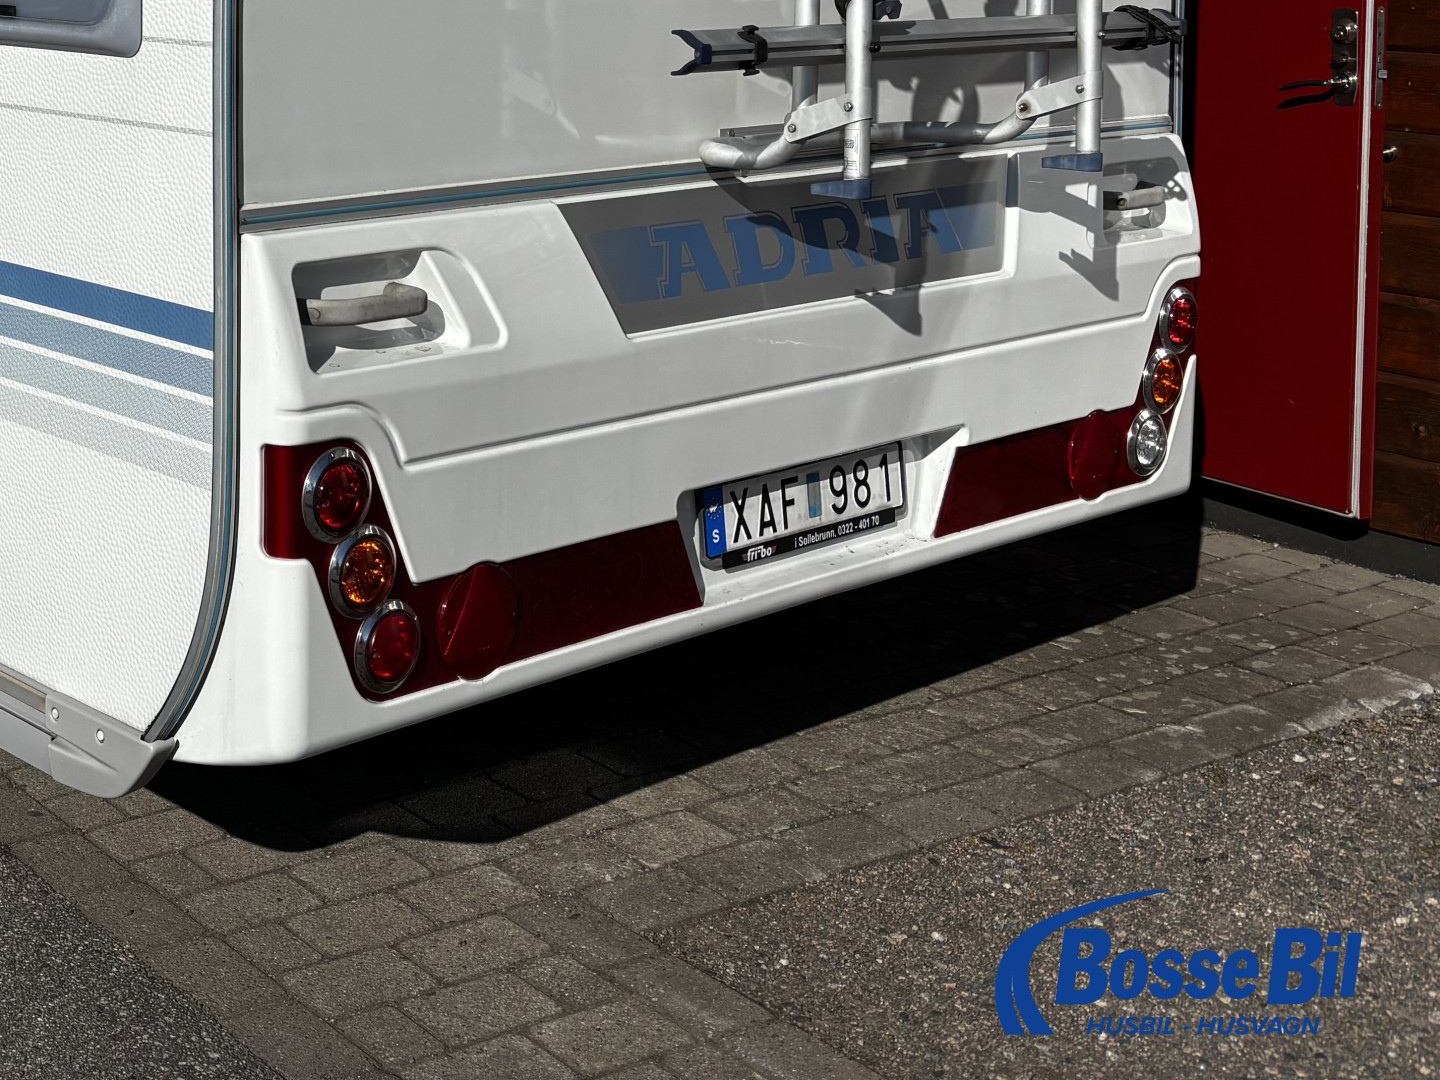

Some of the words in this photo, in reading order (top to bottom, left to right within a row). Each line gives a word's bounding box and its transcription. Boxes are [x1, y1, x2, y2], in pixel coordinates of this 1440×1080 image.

[648, 188, 964, 299] ADRIA
[712, 528, 720, 544] S
[730, 476, 799, 544] XAF
[829, 453, 892, 515] 981
[838, 522, 854, 536] 0322
[859, 519, 870, 530] 401
[871, 515, 880, 526] 70
